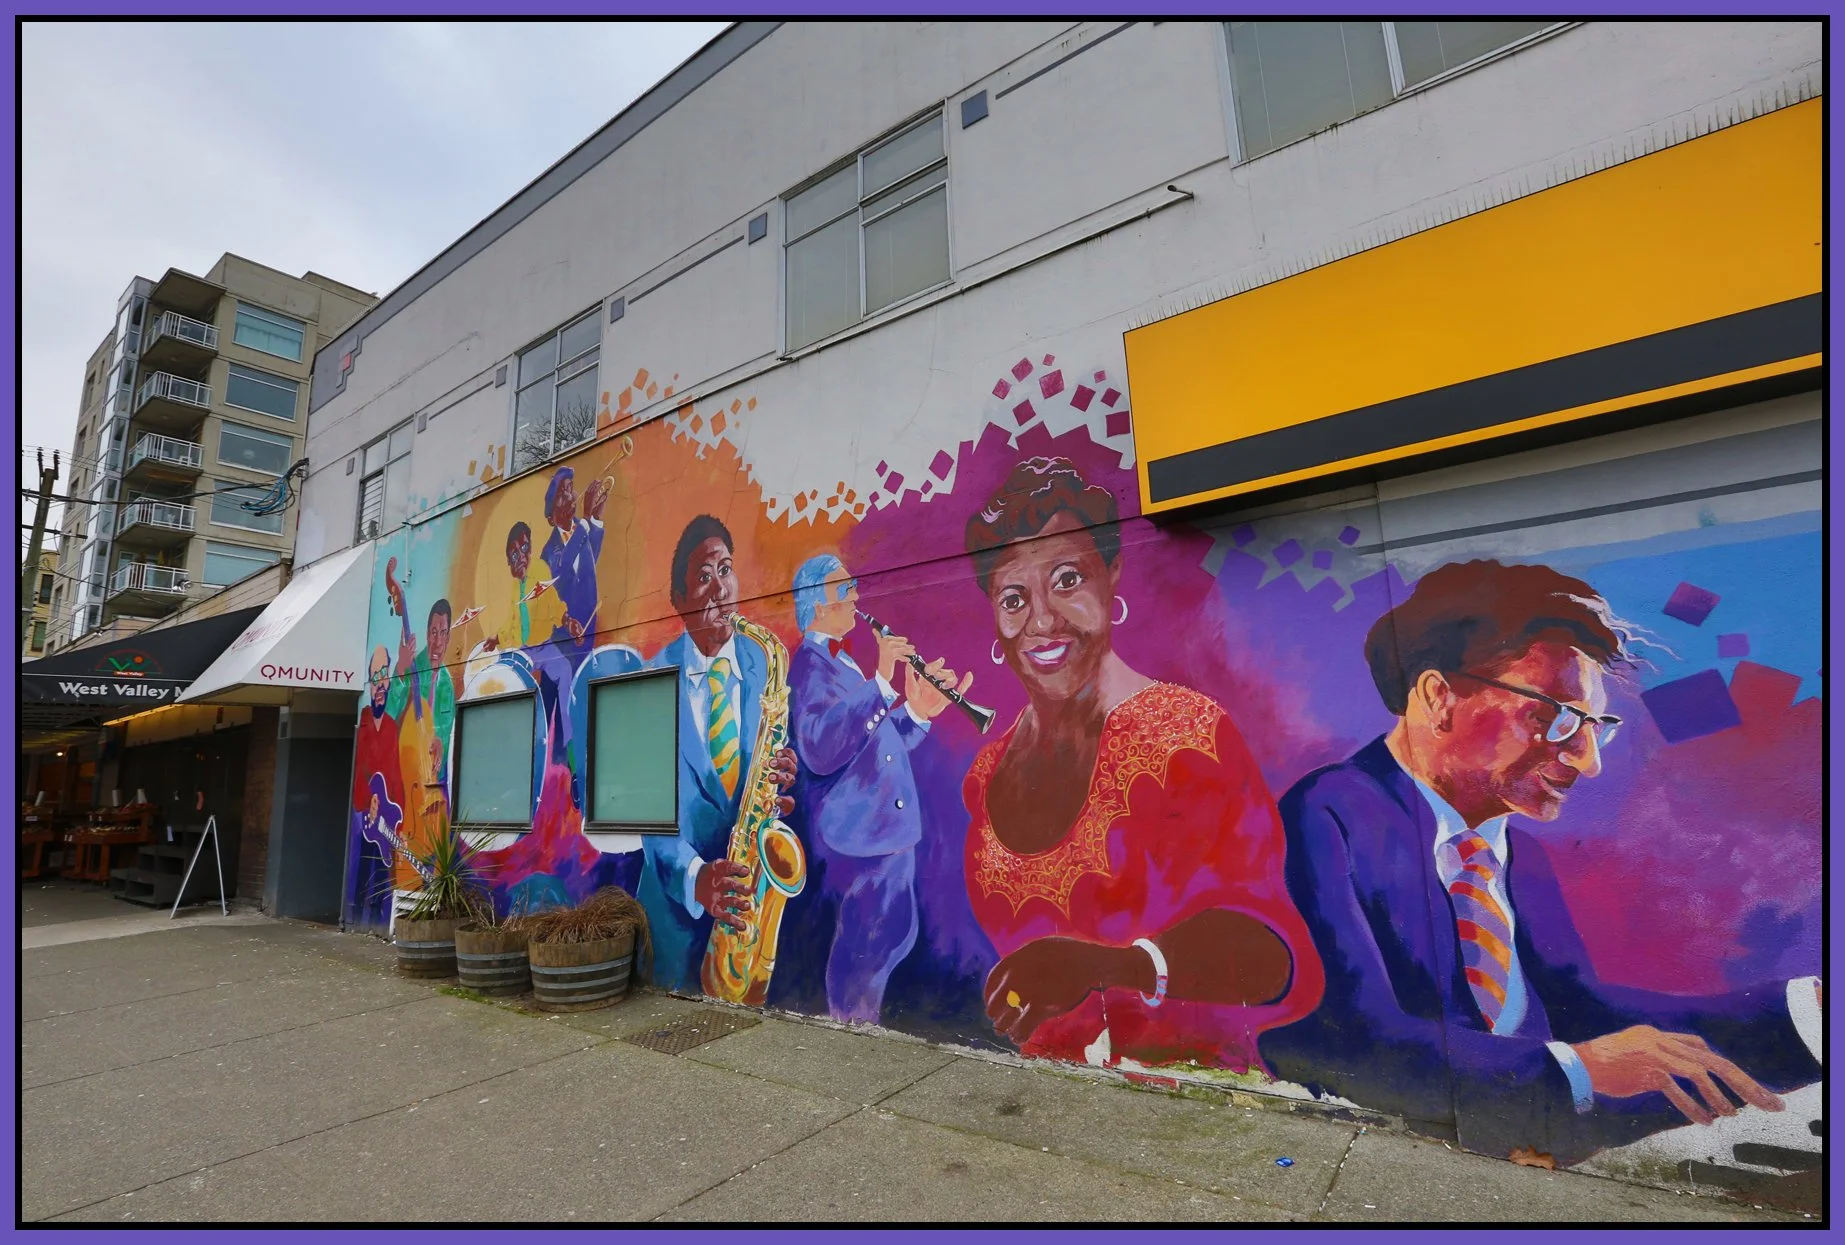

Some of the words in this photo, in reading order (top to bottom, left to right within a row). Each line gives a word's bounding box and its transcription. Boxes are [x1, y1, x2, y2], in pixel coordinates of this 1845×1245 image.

[260, 664, 355, 683] QMUNITY
[59, 682, 108, 696] West
[113, 684, 169, 699] Valley
